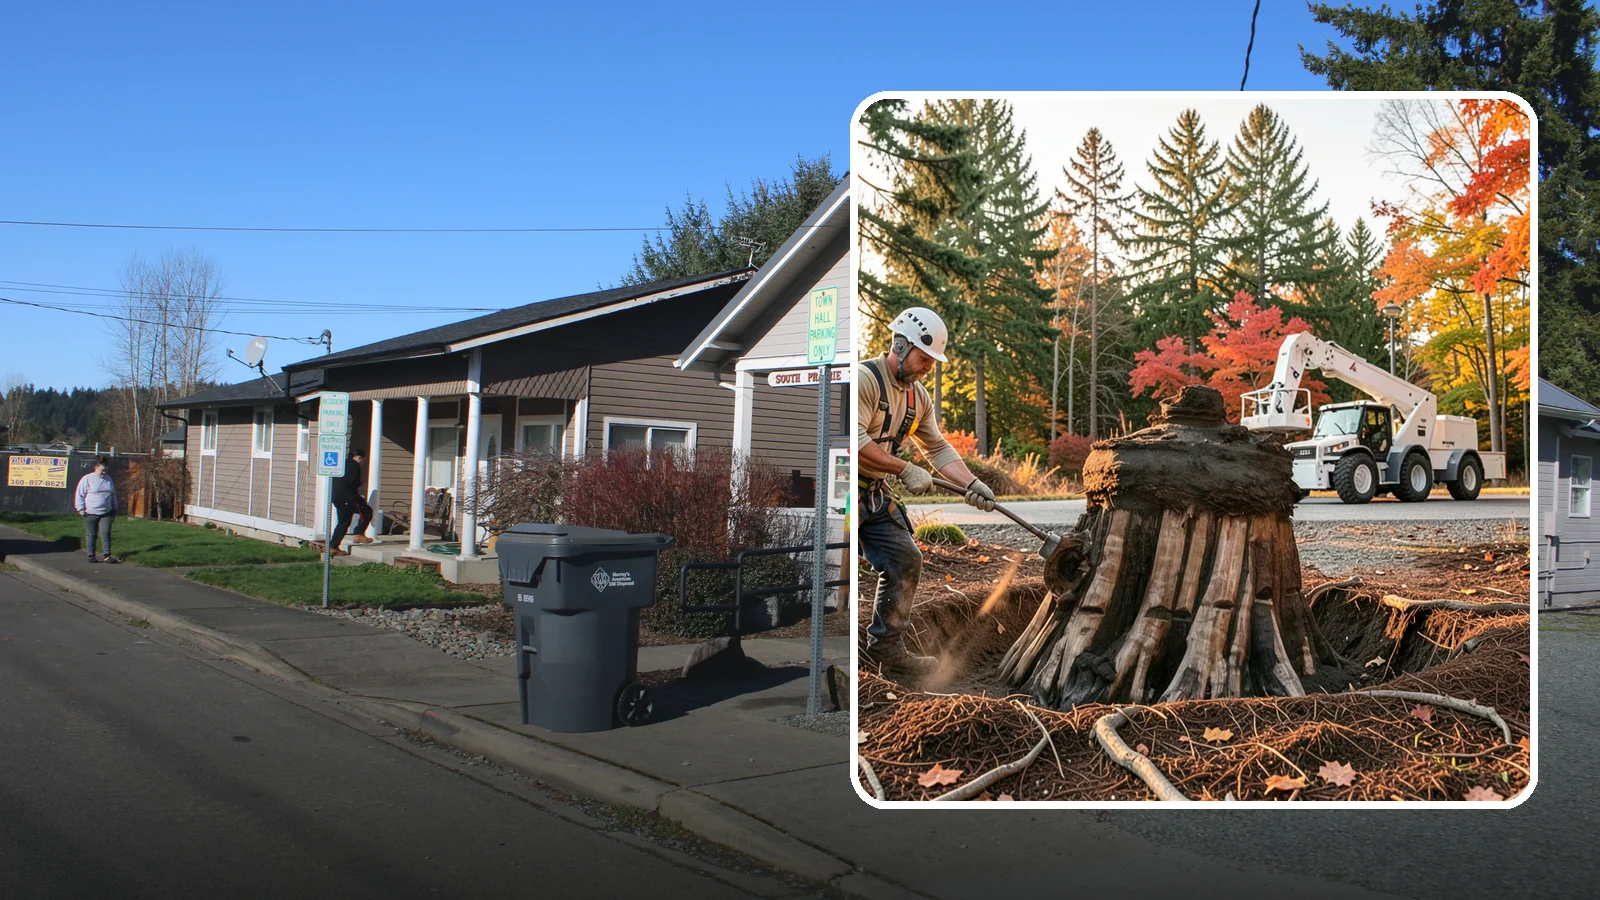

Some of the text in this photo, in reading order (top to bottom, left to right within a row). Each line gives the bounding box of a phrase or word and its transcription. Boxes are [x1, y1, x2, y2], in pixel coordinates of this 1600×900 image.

[815, 294, 832, 308] TOWN
[814, 312, 831, 324] HALL
[810, 326, 836, 340] PARKING
[814, 344, 830, 356] ONLY
[776, 374, 800, 384] SOUTH
